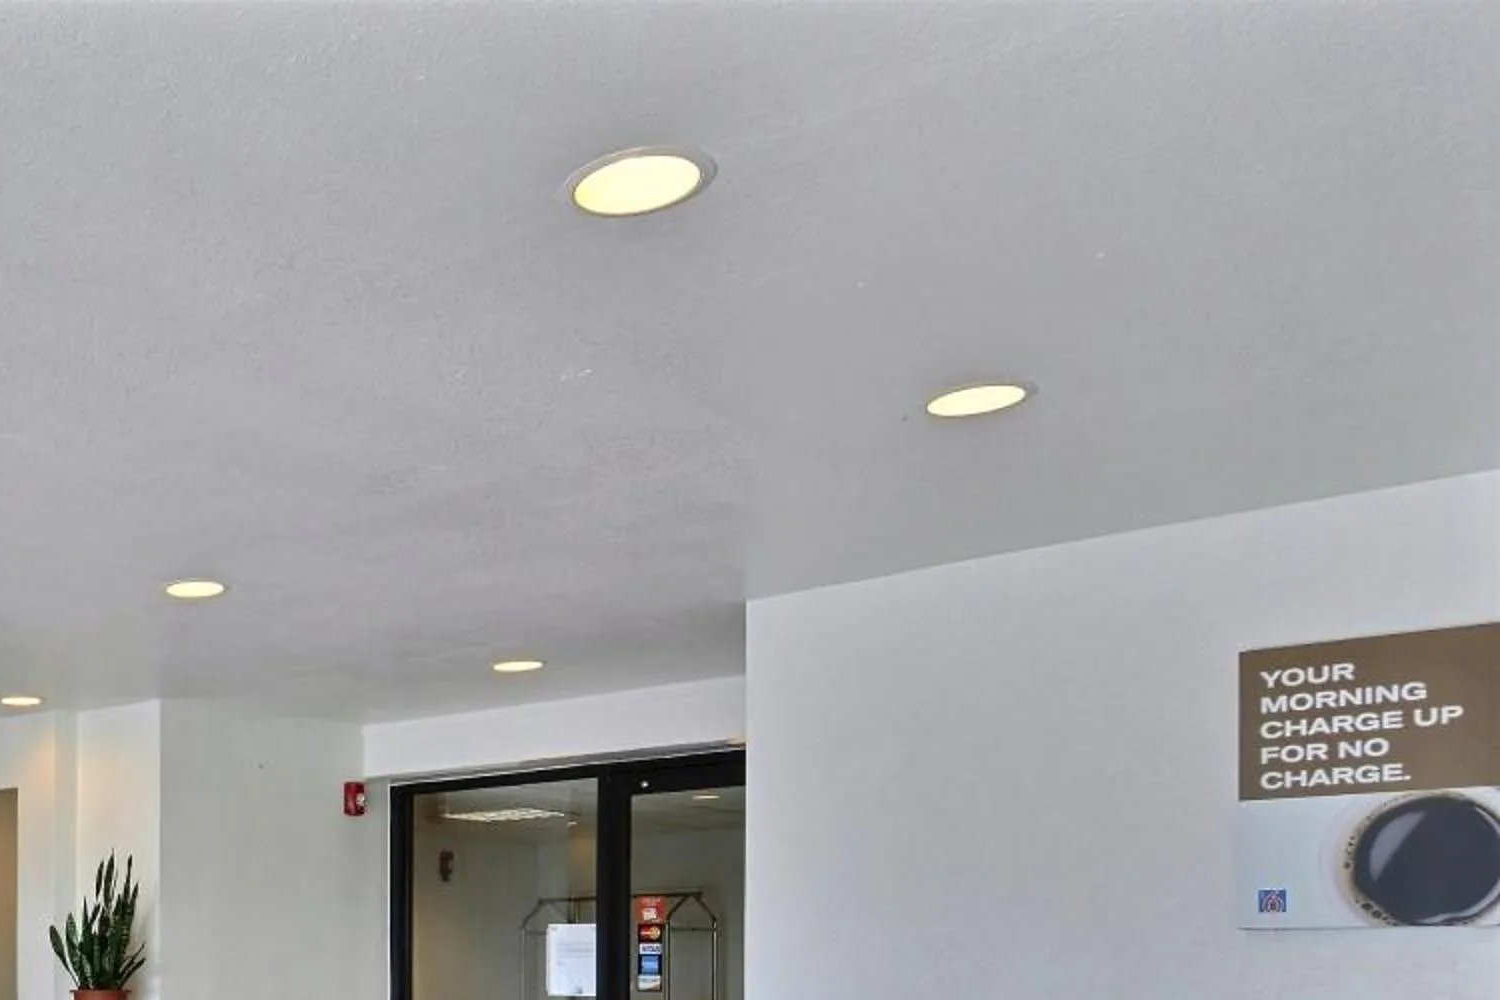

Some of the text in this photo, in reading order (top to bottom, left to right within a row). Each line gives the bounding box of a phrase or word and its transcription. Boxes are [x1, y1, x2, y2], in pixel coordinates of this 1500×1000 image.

[1260, 662, 1355, 689] YOUR
[1260, 682, 1428, 714] MORNING
[1260, 705, 1464, 739] CHARGE UP
[1260, 738, 1390, 765] FOR NO
[1260, 763, 1411, 790] CHARGE.
